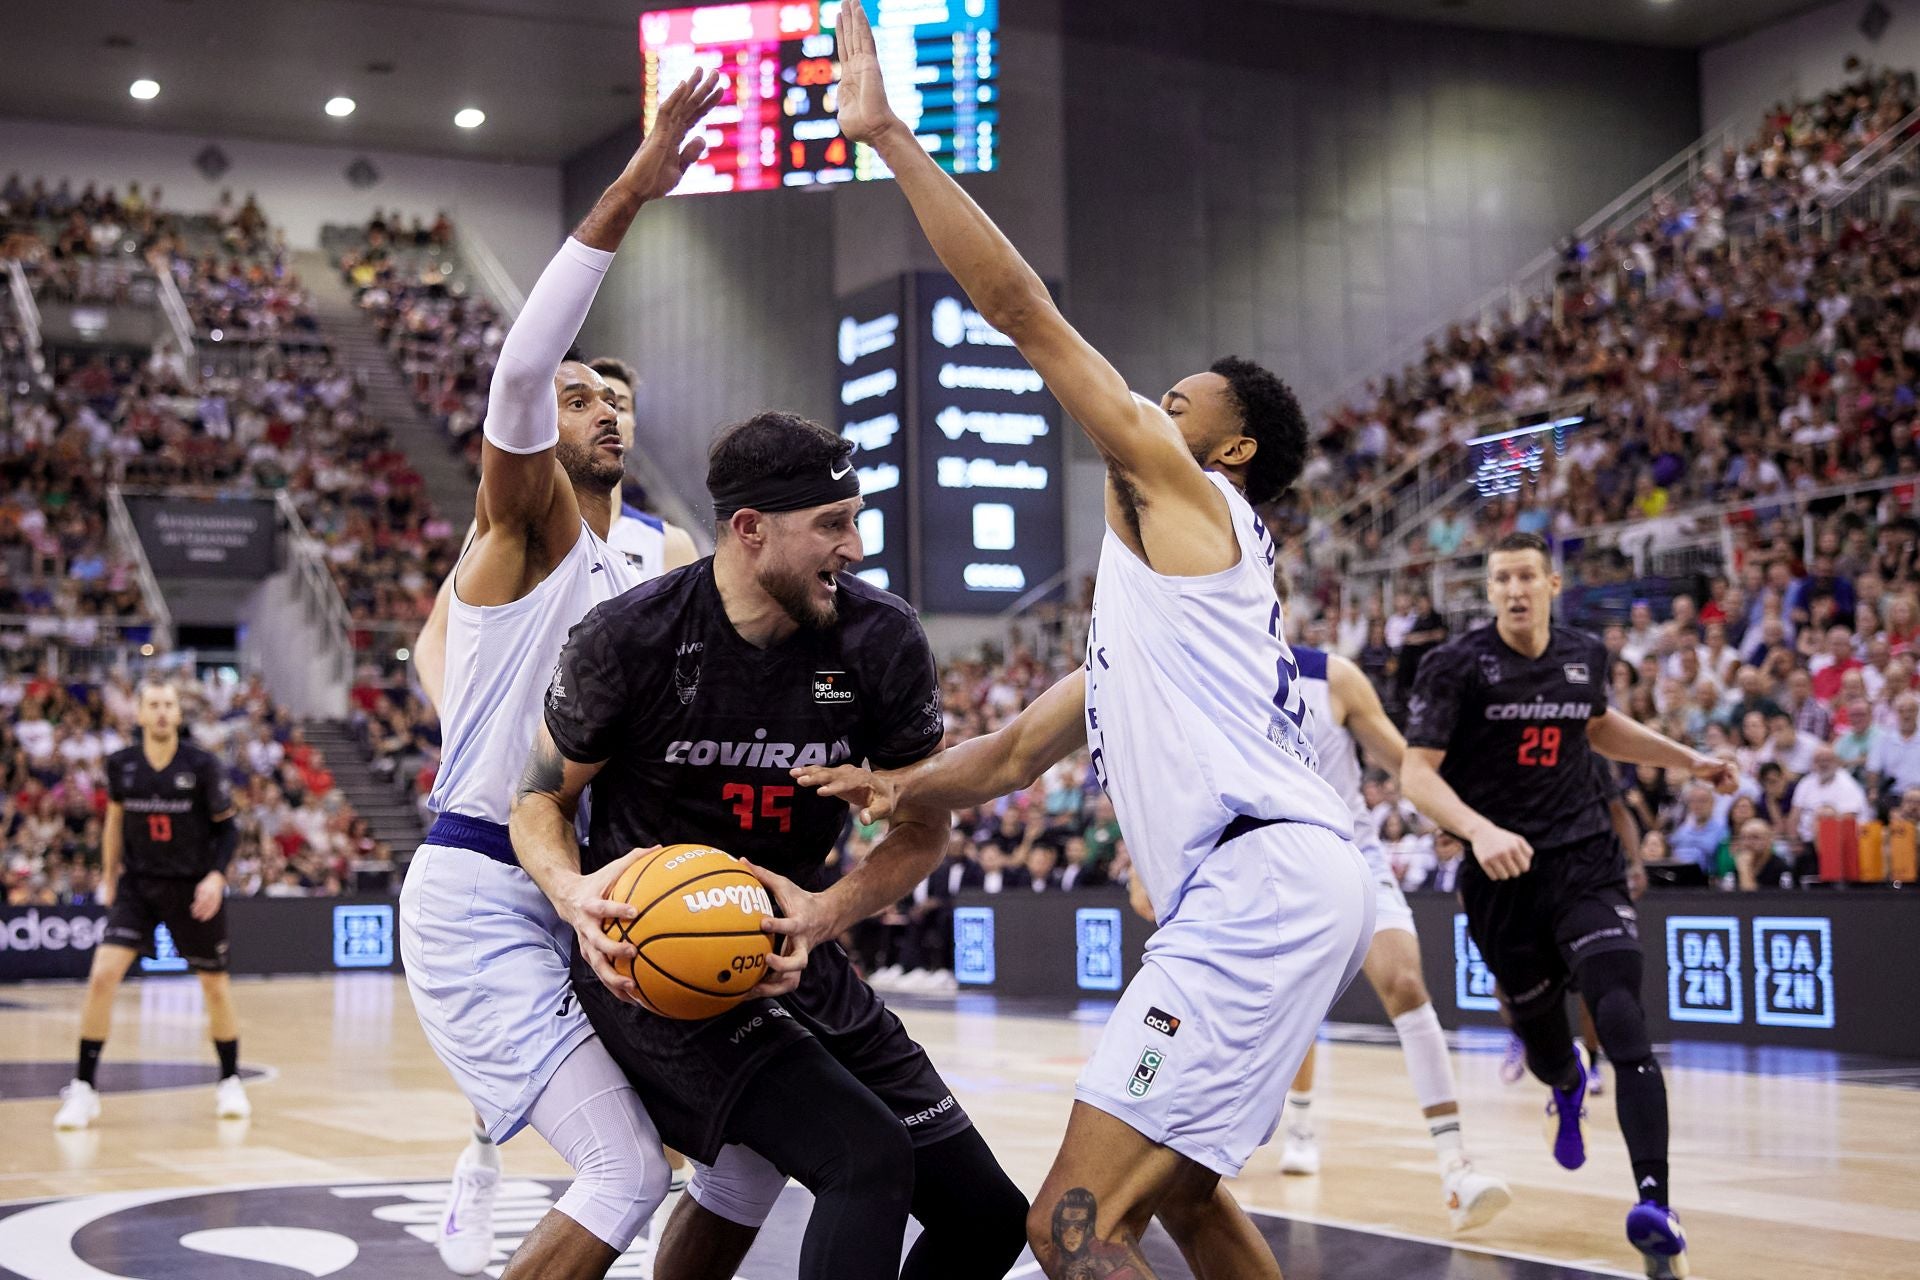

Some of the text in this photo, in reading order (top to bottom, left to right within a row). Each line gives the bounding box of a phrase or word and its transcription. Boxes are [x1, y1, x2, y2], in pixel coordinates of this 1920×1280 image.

[675, 641, 704, 656] vive
[815, 689, 852, 699] endesa
[1485, 695, 1591, 720] COVIRAN
[1517, 726, 1561, 767] 29
[683, 884, 775, 918] Wilson
[732, 953, 764, 973] acb
[729, 1016, 763, 1044] vive
[1146, 1015, 1170, 1033] acb
